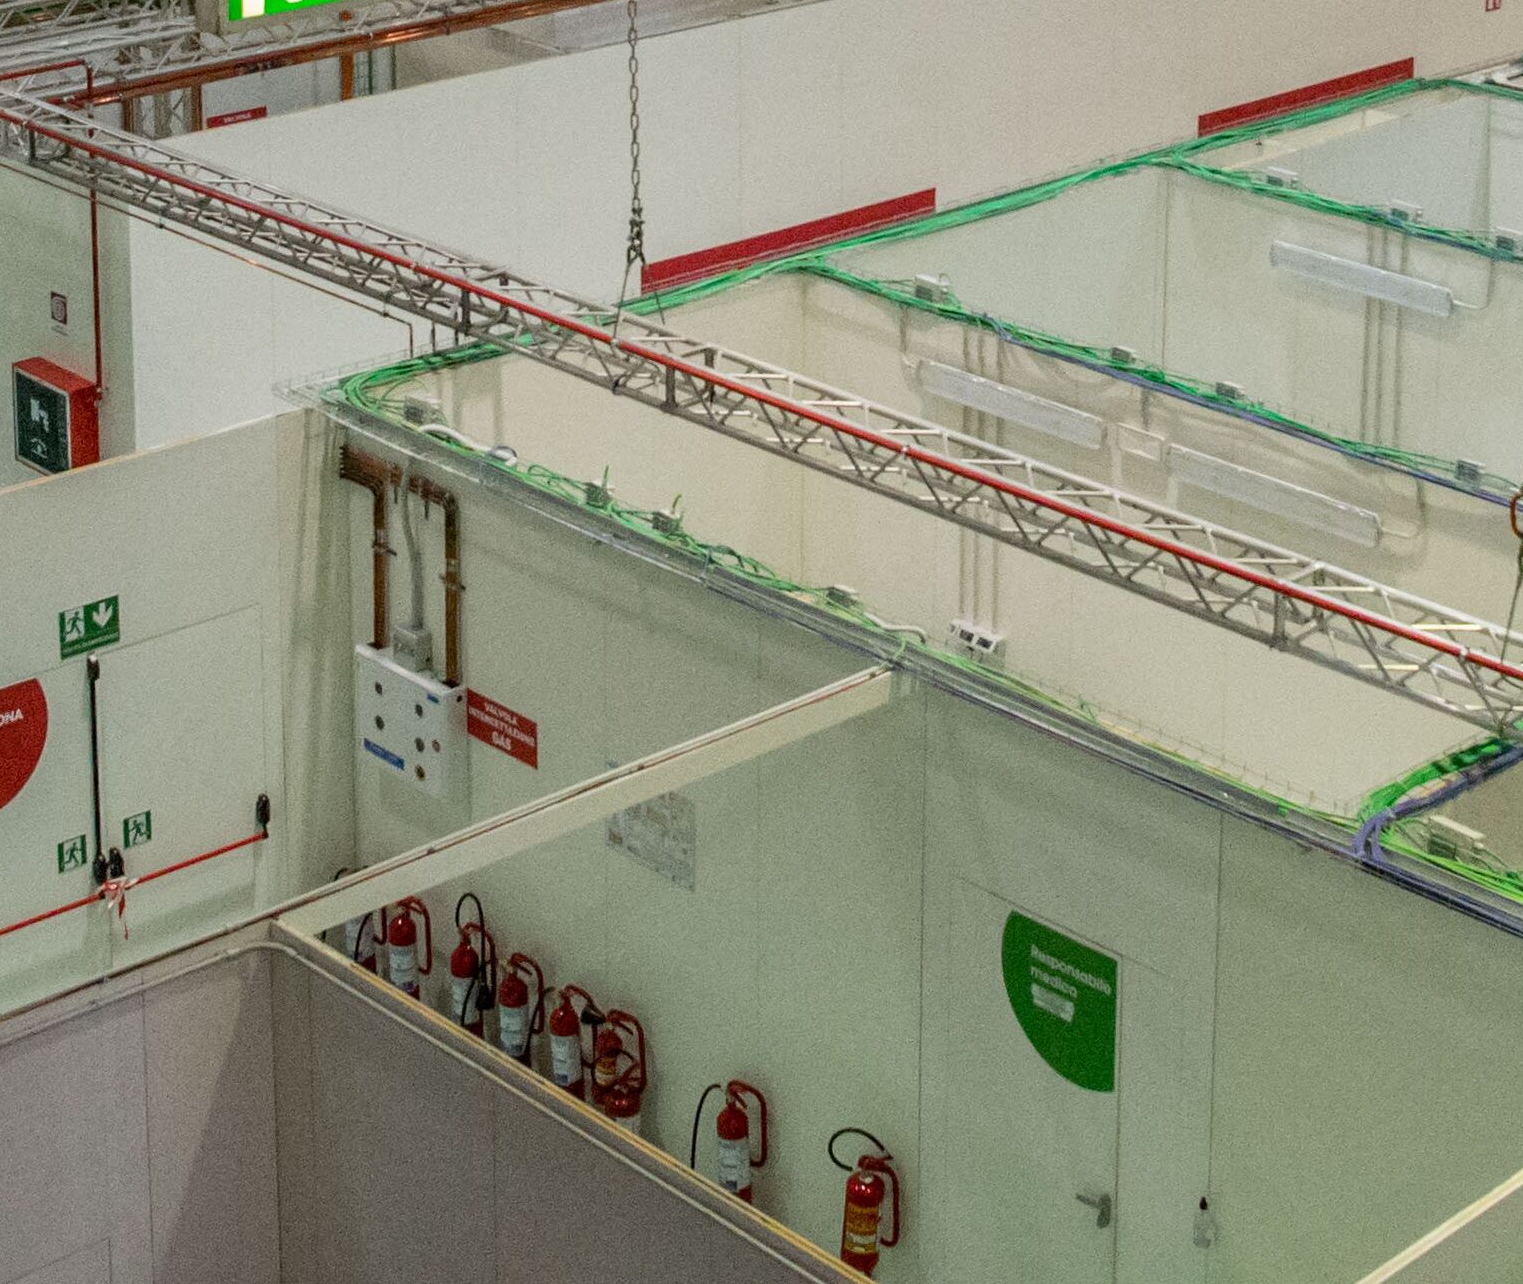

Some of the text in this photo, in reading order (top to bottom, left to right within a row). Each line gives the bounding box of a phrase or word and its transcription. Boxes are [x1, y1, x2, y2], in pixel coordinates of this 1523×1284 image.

[491, 731, 512, 751] GAS
[1030, 943, 1112, 997] Responsabile
[1030, 965, 1078, 998] medico
